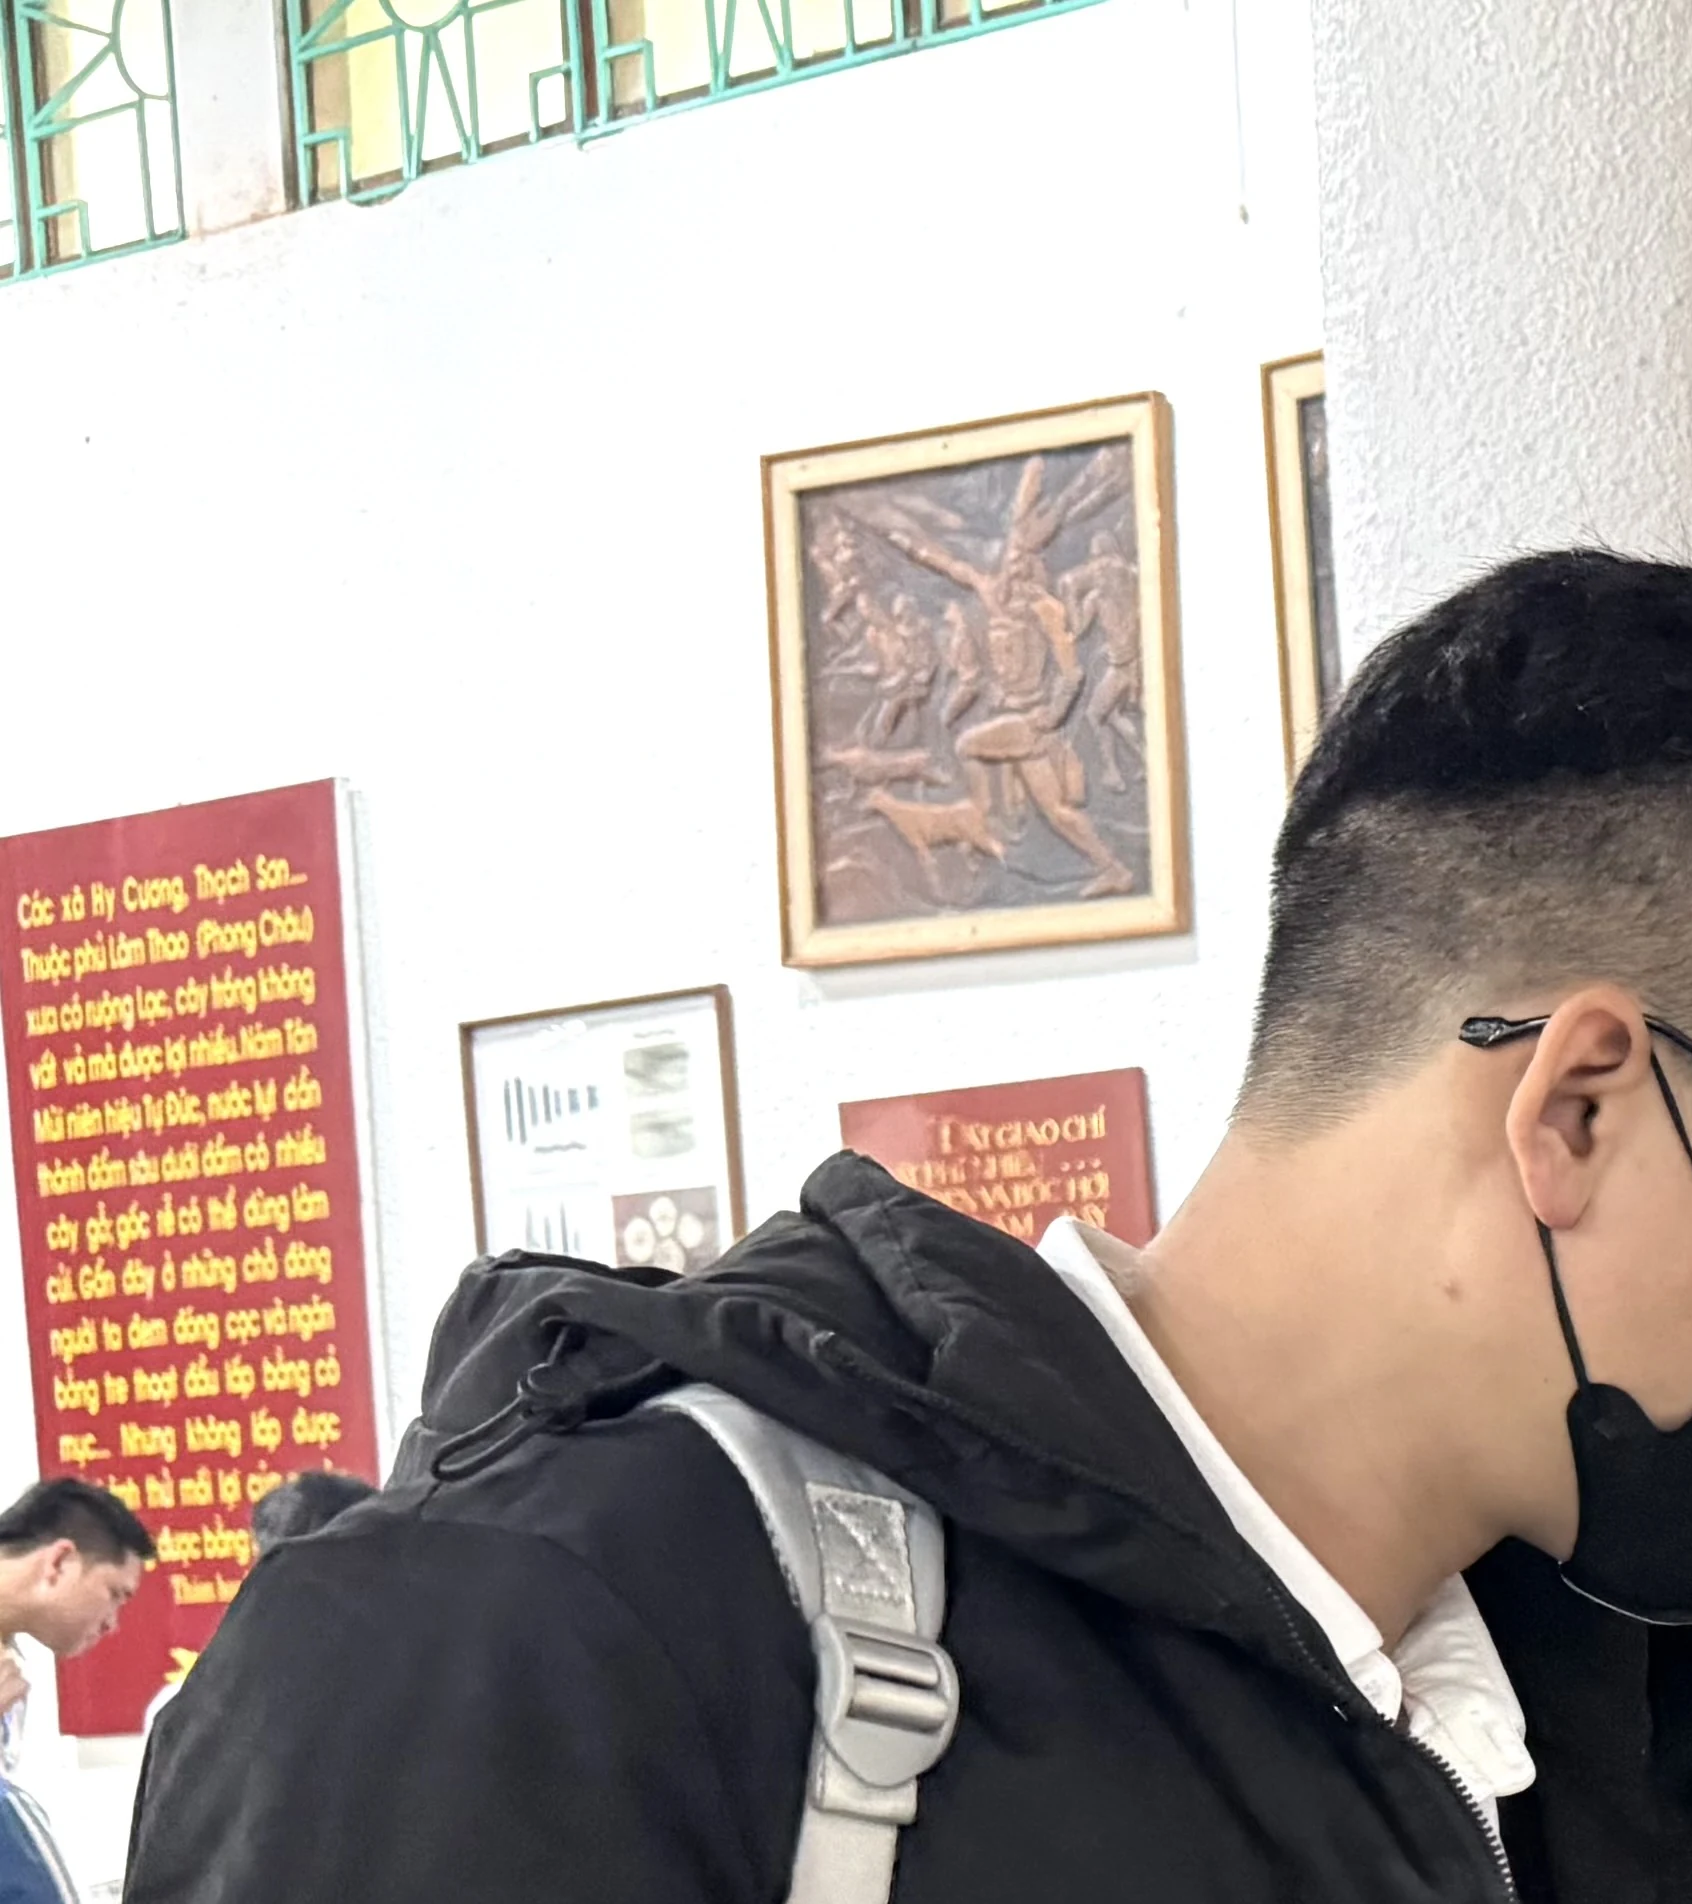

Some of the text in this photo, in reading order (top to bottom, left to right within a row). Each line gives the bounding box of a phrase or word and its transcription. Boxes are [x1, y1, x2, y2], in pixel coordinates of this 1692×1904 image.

[18, 888, 55, 930] Các
[91, 882, 116, 922] Hy
[193, 858, 250, 905] Thạch
[21, 943, 71, 986] Thuộc
[74, 930, 107, 983] phủ
[109, 932, 146, 970] Lâm
[146, 928, 189, 964] Thao
[26, 1005, 58, 1037] xưa
[60, 992, 83, 1032] có
[258, 962, 316, 1005] không
[88, 1042, 117, 1082] mà
[118, 1040, 163, 1083] được
[164, 1034, 187, 1079] lợi
[104, 1096, 142, 1140] hiệu
[142, 1093, 164, 1137] Tự
[207, 1080, 252, 1121] nước
[244, 1131, 270, 1172] có
[275, 1122, 327, 1168] nhiều
[46, 1213, 78, 1255] cây
[177, 1195, 202, 1235] có
[121, 1258, 155, 1300] đây
[181, 1248, 237, 1294] những
[102, 1317, 123, 1352] ta
[224, 1308, 262, 1346] cọc
[104, 1370, 129, 1405] tre
[185, 1414, 242, 1458] không
[292, 1406, 342, 1451] được
